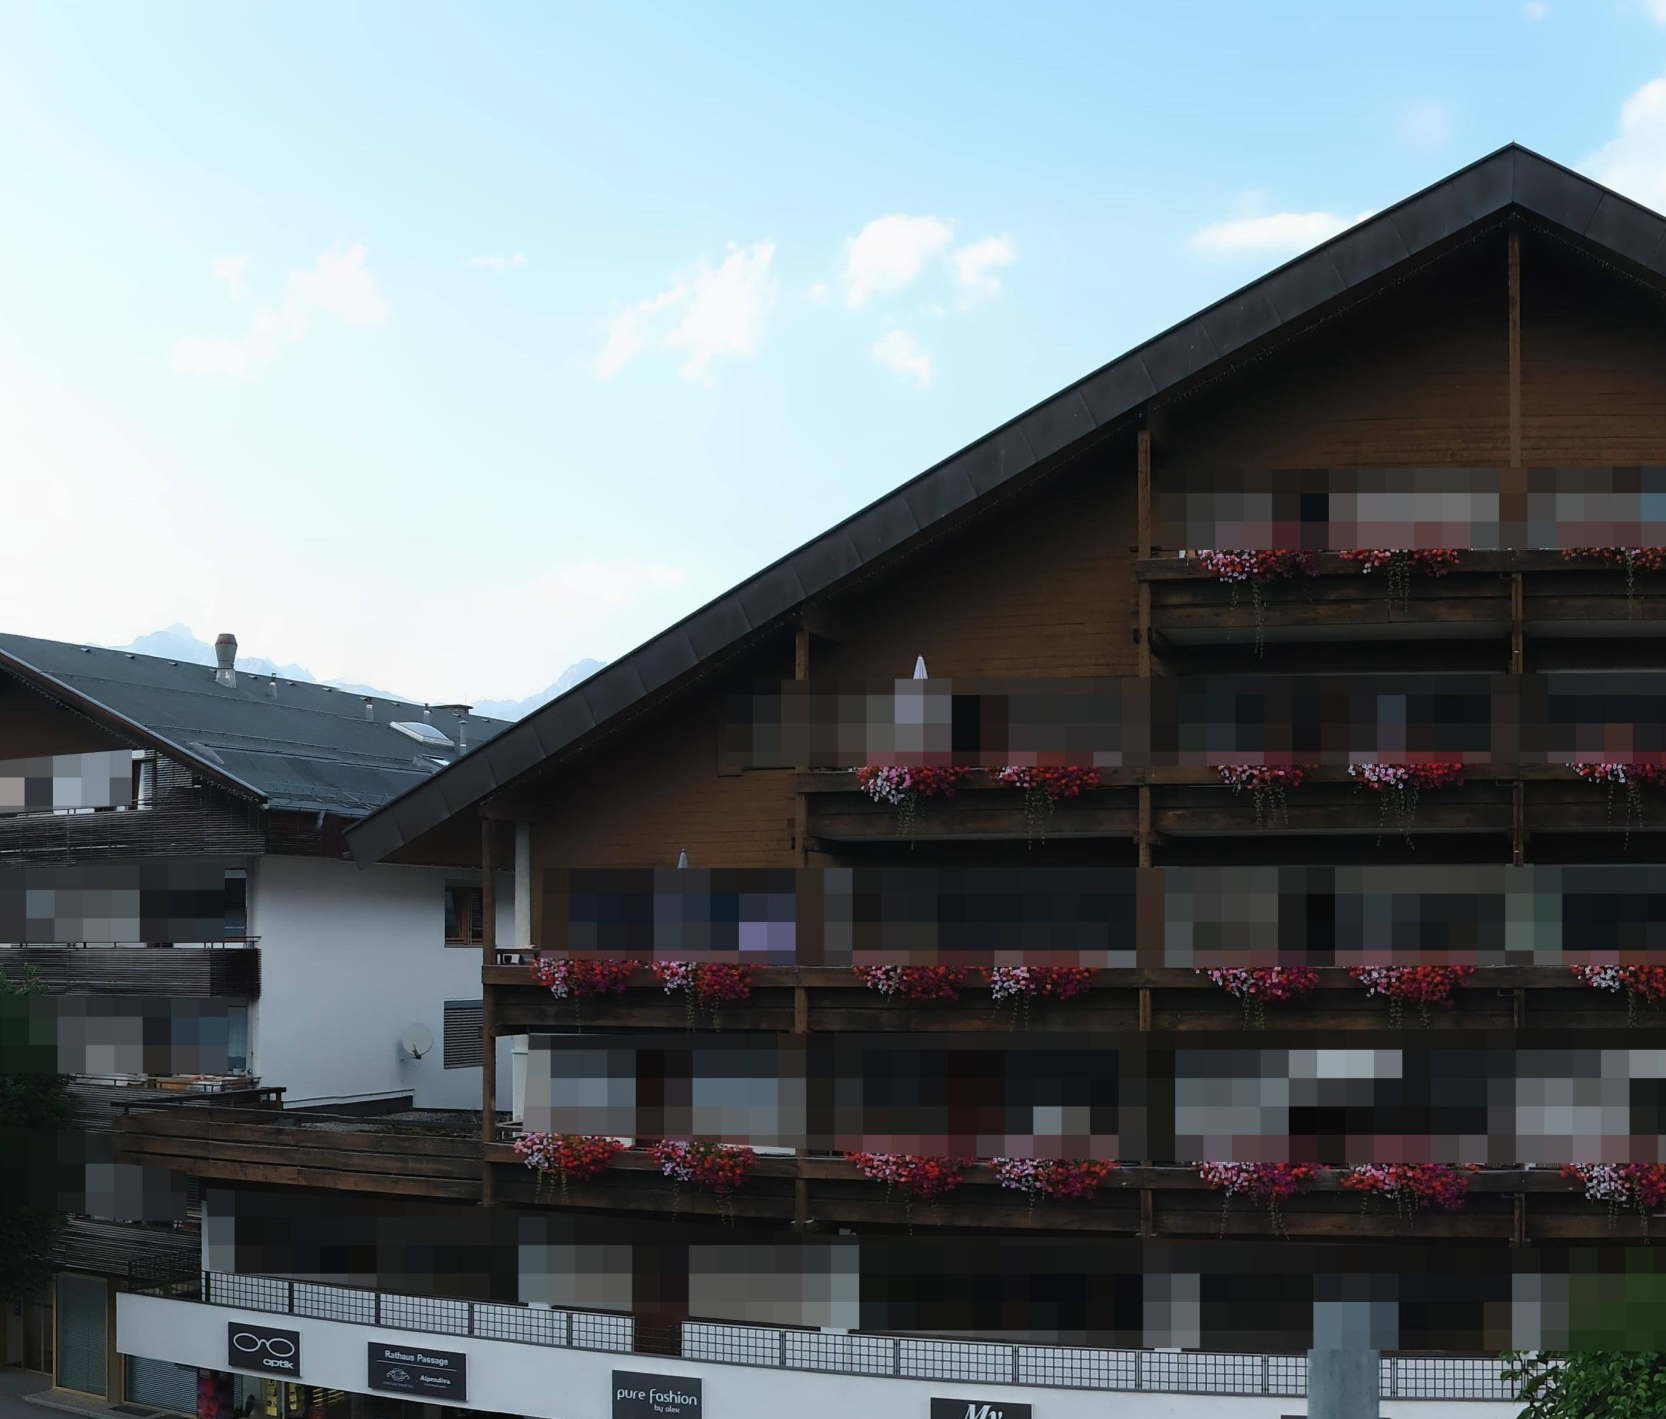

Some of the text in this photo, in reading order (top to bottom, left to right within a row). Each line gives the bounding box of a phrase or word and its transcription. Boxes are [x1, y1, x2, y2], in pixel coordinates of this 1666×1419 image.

[263, 1358, 294, 1370] optik
[385, 1350, 449, 1367] Rathaus Passage
[617, 1388, 698, 1406] pure fashion
[654, 1404, 680, 1414] by alex
